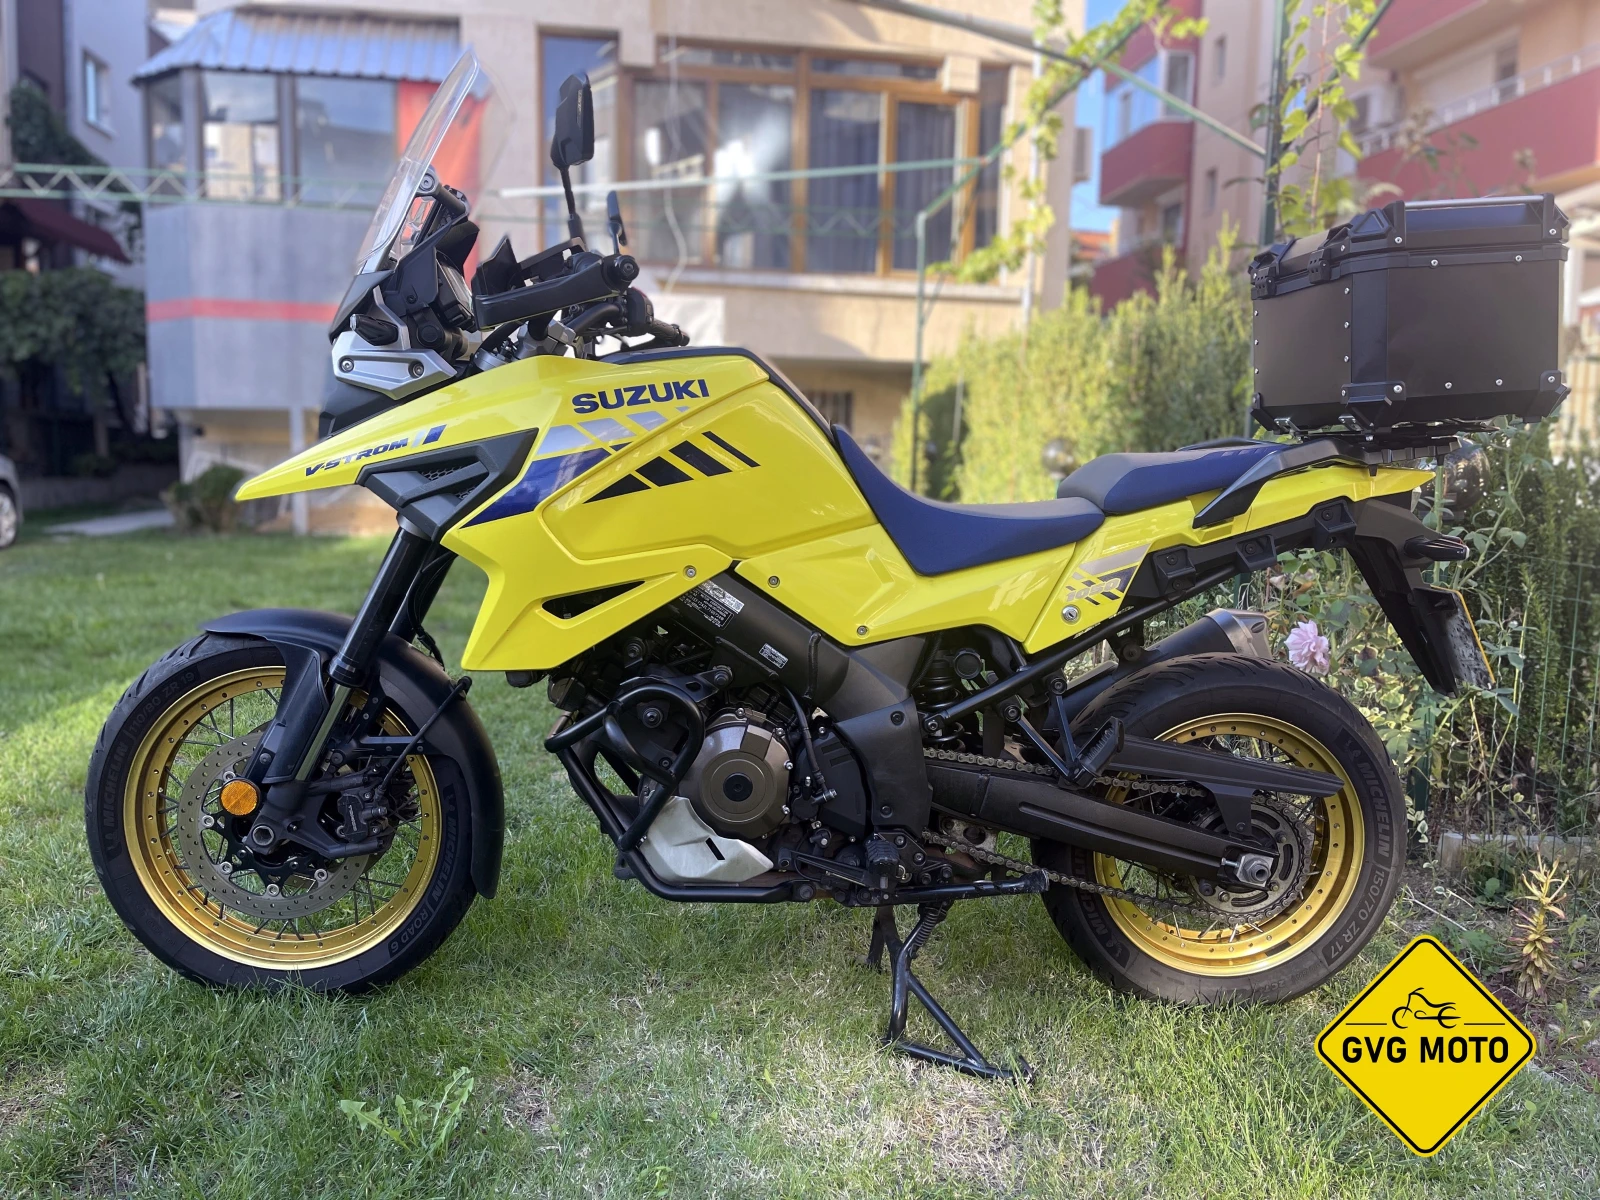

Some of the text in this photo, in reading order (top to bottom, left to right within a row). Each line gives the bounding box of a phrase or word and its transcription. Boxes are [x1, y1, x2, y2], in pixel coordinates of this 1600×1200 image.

[572, 379, 710, 414] SUZUKI
[305, 438, 409, 476] V-STROM
[1066, 577, 1120, 602] 1050
[130, 672, 195, 732] 110/80 ZR 19
[103, 742, 129, 827] MICHELIN
[431, 816, 457, 902] MICHELIN
[1331, 762, 1390, 958] MICHELIN 150/70 ZR 17
[400, 908, 430, 944] ROAD
[390, 942, 400, 953] 6
